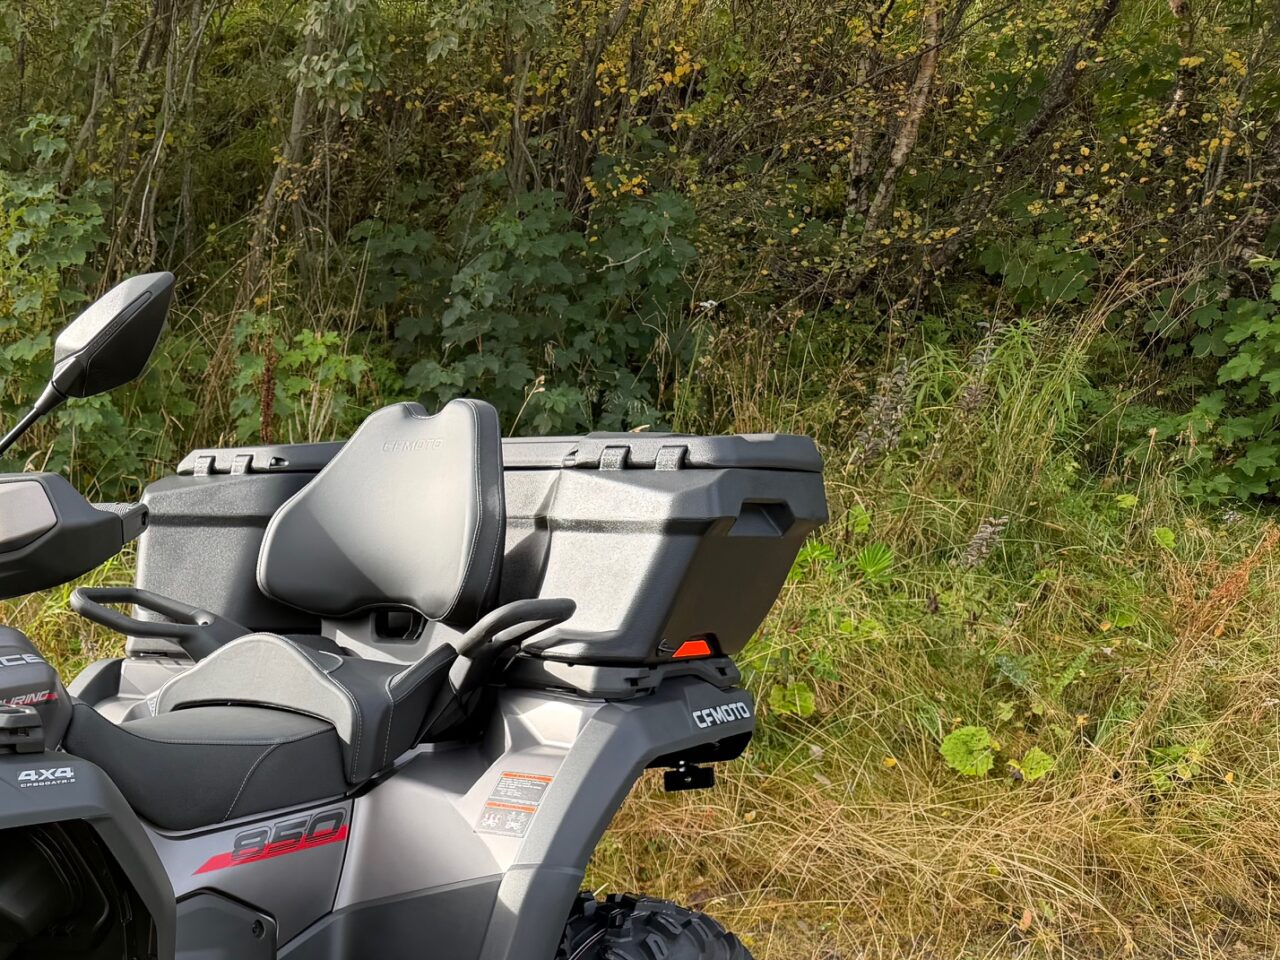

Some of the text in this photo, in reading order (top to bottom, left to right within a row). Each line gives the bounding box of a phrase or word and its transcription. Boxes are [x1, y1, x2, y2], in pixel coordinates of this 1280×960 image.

[3, 690, 50, 705] URING
[693, 702, 751, 728] CFMOTO
[18, 767, 74, 781] 4X4
[231, 807, 347, 861] 850
